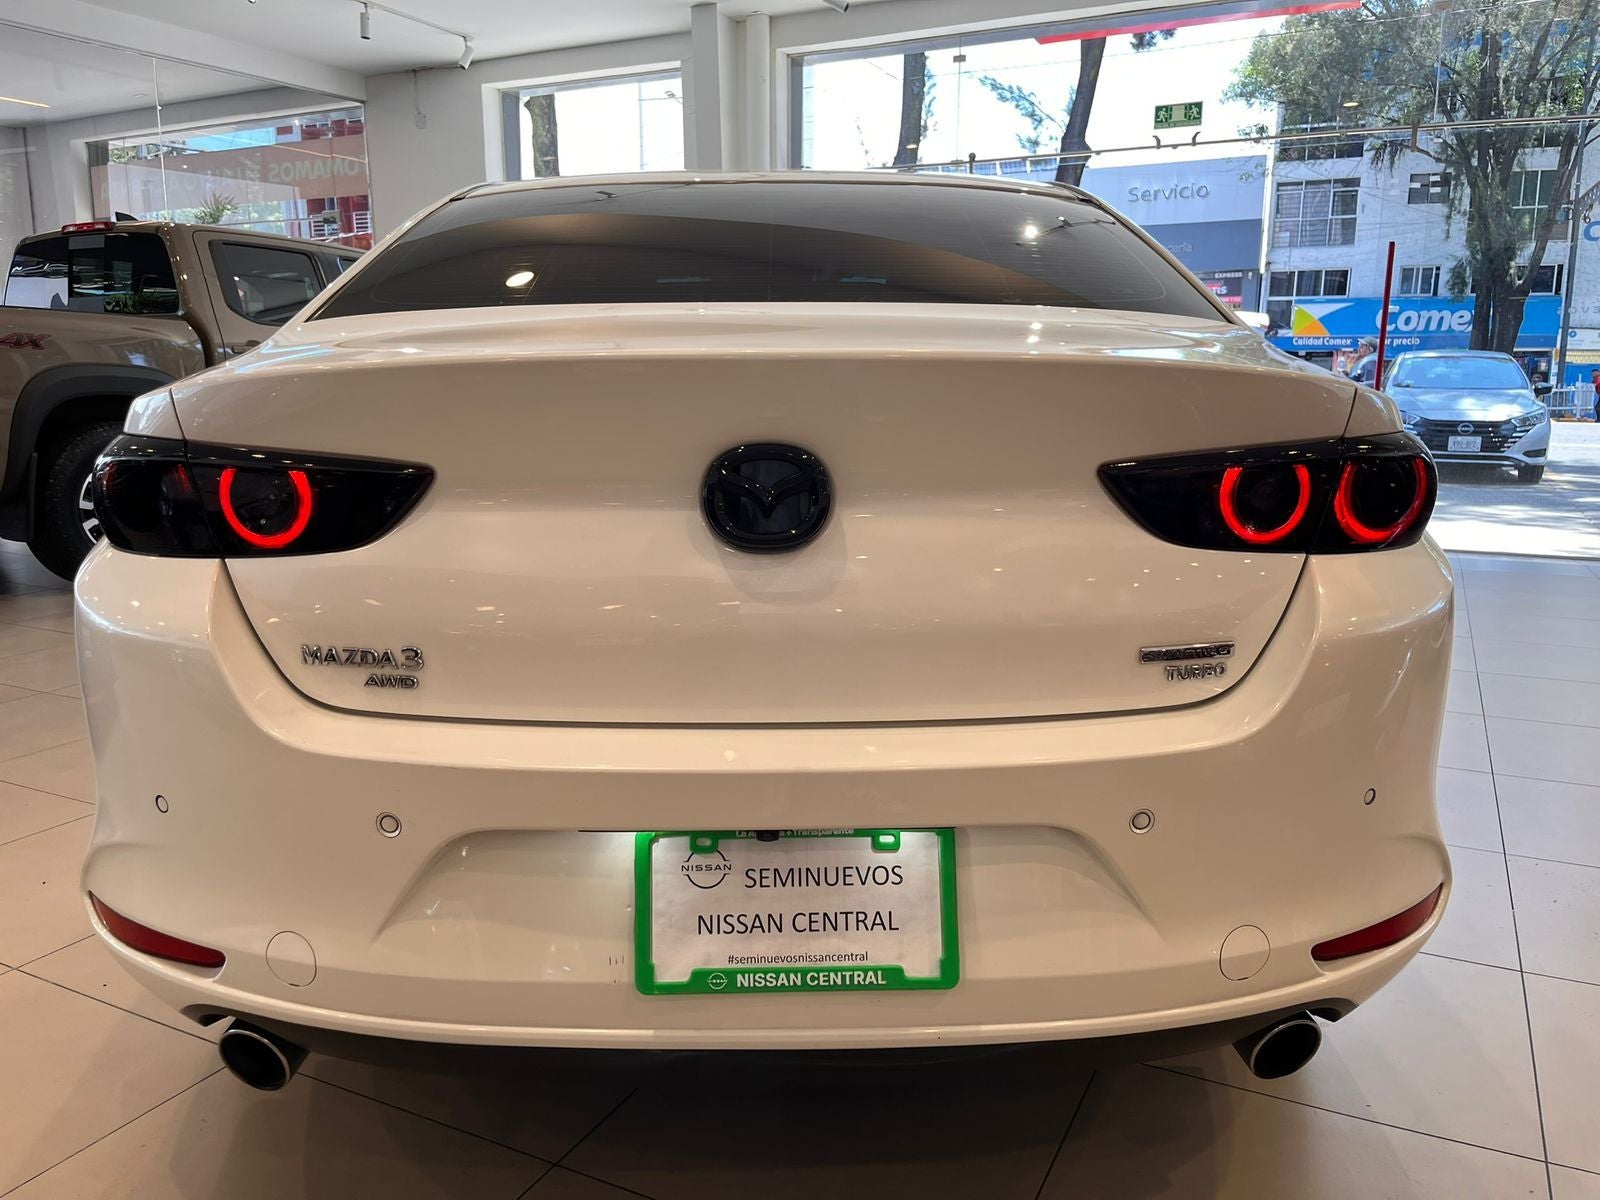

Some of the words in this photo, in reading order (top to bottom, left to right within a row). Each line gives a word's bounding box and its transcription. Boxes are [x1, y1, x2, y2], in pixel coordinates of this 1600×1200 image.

[1127, 183, 1210, 202] Servicio
[1375, 306, 1475, 332] Come
[1292, 336, 1323, 346] Calidad
[1324, 337, 1352, 346] Comex
[1393, 336, 1420, 347] precio
[1166, 662, 1227, 680] TURBO
[364, 673, 419, 689] AWD
[681, 862, 732, 873] NISSAN
[744, 864, 904, 889] SEMINUEVOS
[697, 913, 783, 936] NISSAN
[791, 910, 900, 933] CENTRAL
[727, 951, 869, 966] #seminuevosnissancentral
[736, 973, 802, 988] NISSAN
[805, 970, 887, 986] CENTRAL
